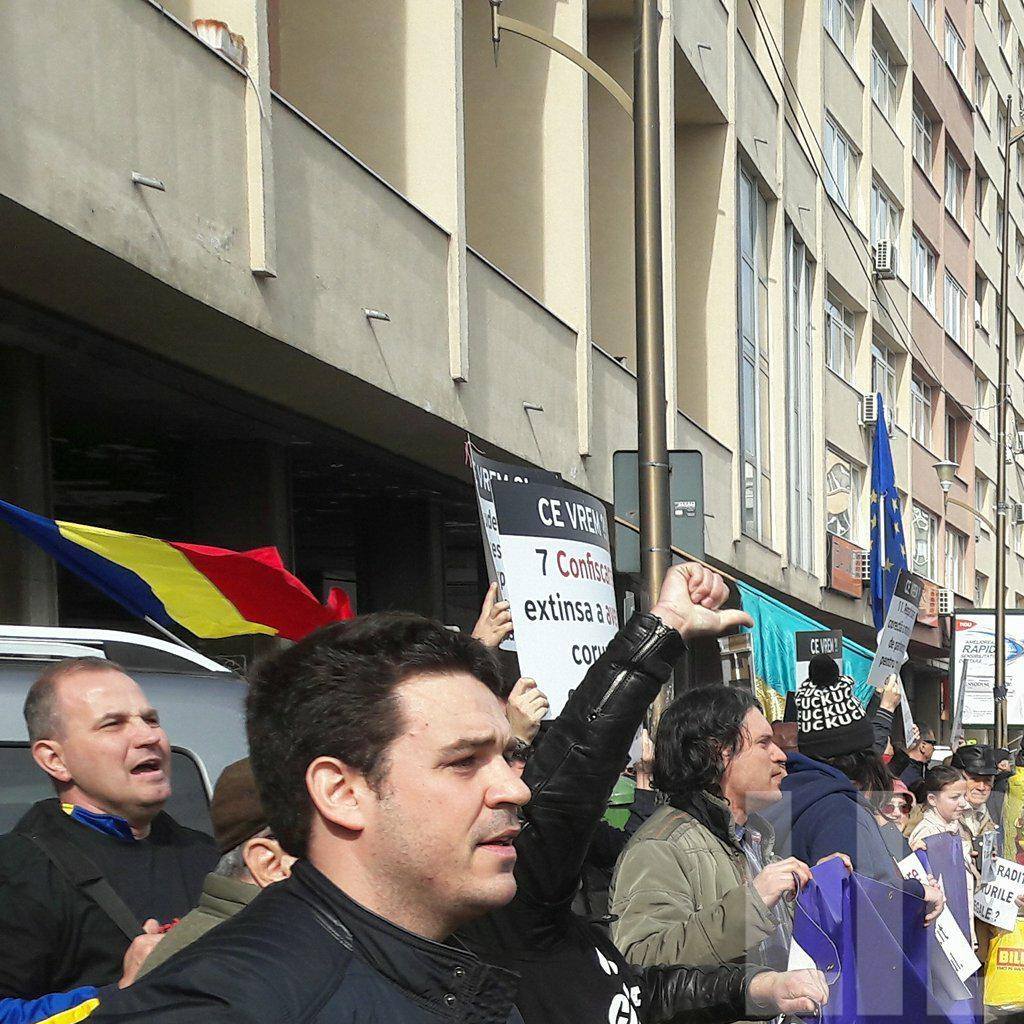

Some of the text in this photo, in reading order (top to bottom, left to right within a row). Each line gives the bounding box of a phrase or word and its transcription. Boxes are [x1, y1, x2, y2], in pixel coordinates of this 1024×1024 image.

[537, 497, 565, 528] CE
[565, 501, 602, 537] VREM
[535, 548, 548, 576] 7
[524, 592, 594, 623] extinsa
[595, 602, 605, 624] a
[810, 637, 820, 655] CE
[994, 910, 1000, 922] ?
